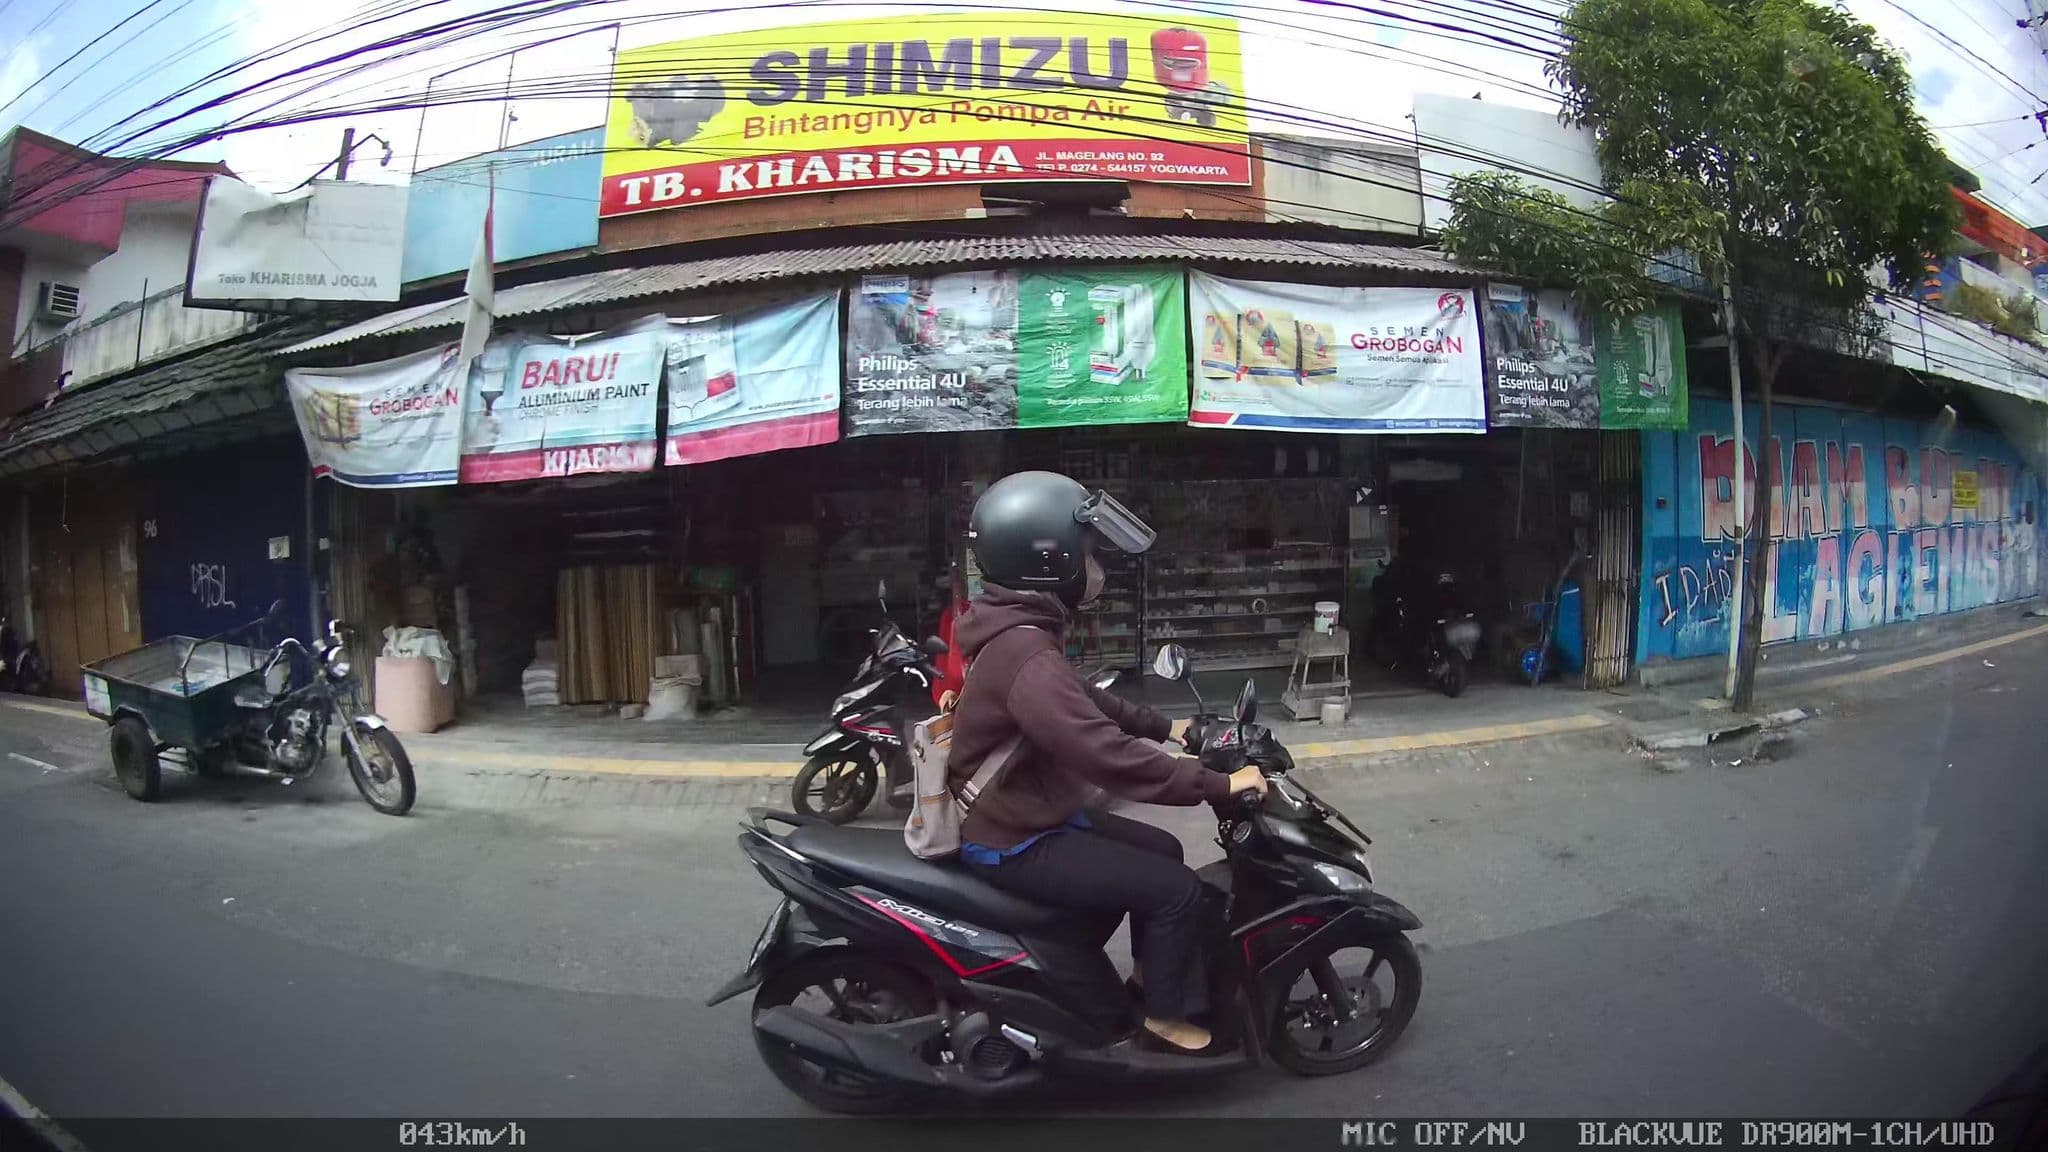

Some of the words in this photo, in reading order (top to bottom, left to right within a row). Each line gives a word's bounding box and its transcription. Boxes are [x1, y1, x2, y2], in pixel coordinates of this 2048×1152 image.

[746, 36, 1129, 106] SHIMIZU
[743, 109, 936, 140] Bintangnya
[951, 100, 1069, 127] Pompa
[1081, 99, 1132, 122] Air
[1056, 152, 1125, 161] MAGELANG
[1127, 152, 1148, 162] NO.
[1150, 152, 1165, 161] 92
[619, 171, 702, 205] TB.
[716, 145, 1025, 193] KHARISMA
[1071, 163, 1098, 173] 0274
[1149, 164, 1229, 175] YOGYAKARTA
[218, 273, 246, 284] Toko
[250, 271, 327, 287] KHARISMA
[331, 274, 377, 288] JOGJA
[1370, 326, 1444, 337] SEMEN
[1351, 333, 1463, 353] GROBOGAN
[521, 352, 620, 389] BARU!
[859, 355, 918, 373] Philips
[1496, 357, 1535, 375] Philips
[385, 383, 443, 398] SEMEN
[858, 374, 936, 392] Essential
[940, 373, 966, 388] 4U
[1498, 375, 1548, 391] Essential
[1551, 377, 1568, 392] 4U
[370, 388, 458, 415] GROBOGAN
[518, 387, 600, 409] ALUMINIUM
[605, 383, 650, 399] PAINT
[858, 398, 900, 411] Terang
[902, 395, 933, 407] lebih
[1499, 393, 1526, 408] Terang
[1528, 395, 1548, 407] lebih
[1550, 396, 1570, 407] lama
[1698, 432, 1867, 543] DIAM
[144, 520, 157, 538] 96
